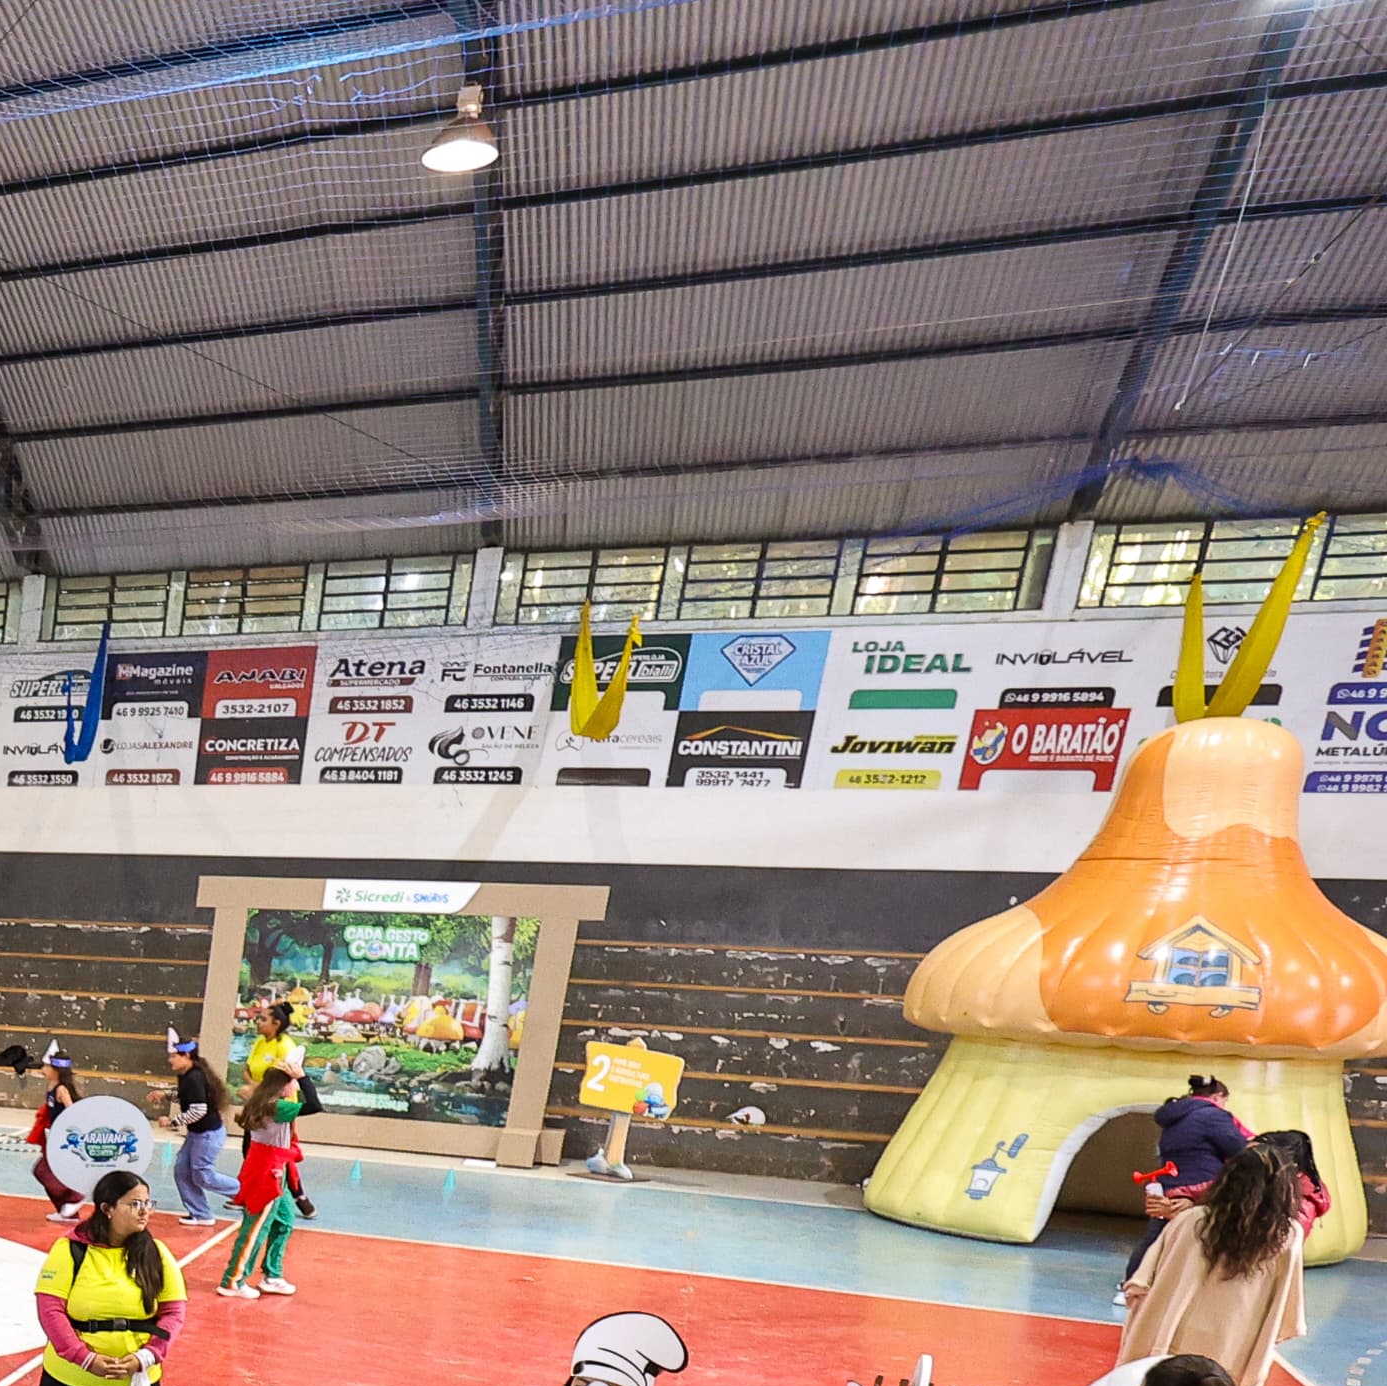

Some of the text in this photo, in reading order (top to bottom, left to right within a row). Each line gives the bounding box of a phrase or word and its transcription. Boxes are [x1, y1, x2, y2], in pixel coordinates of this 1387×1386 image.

[734, 643, 781, 656] CRISTAL
[852, 641, 905, 653] LOJA
[864, 653, 972, 675] IDEAL
[995, 649, 1133, 666] INVIOLÁVEL
[130, 664, 194, 680] Magazine
[329, 658, 425, 678] Atena
[473, 662, 553, 674] Fontanella
[221, 703, 289, 715] 3532-2107
[336, 699, 405, 711] 46 3532 1852
[453, 698, 525, 709] 46 3532 1146
[20, 709, 32, 720] 46
[57, 709, 79, 720] 190
[116, 706, 128, 718] 46
[129, 706, 136, 718] 9
[1011, 716, 1121, 755] O BARATÃO
[3, 742, 66, 756] INVIOLÁV
[204, 738, 300, 752] CONCRETIZA
[677, 740, 804, 757] CONSTANTINI
[1316, 743, 1387, 757] METALÚ
[314, 745, 413, 763] COMPENSADOS
[324, 771, 336, 782] 46
[441, 771, 513, 782] 46 3532 1245
[354, 889, 405, 903] Sicredi
[347, 926, 427, 943] CADA GESTO
[350, 941, 420, 960] CONTA
[586, 1053, 612, 1092] 2
